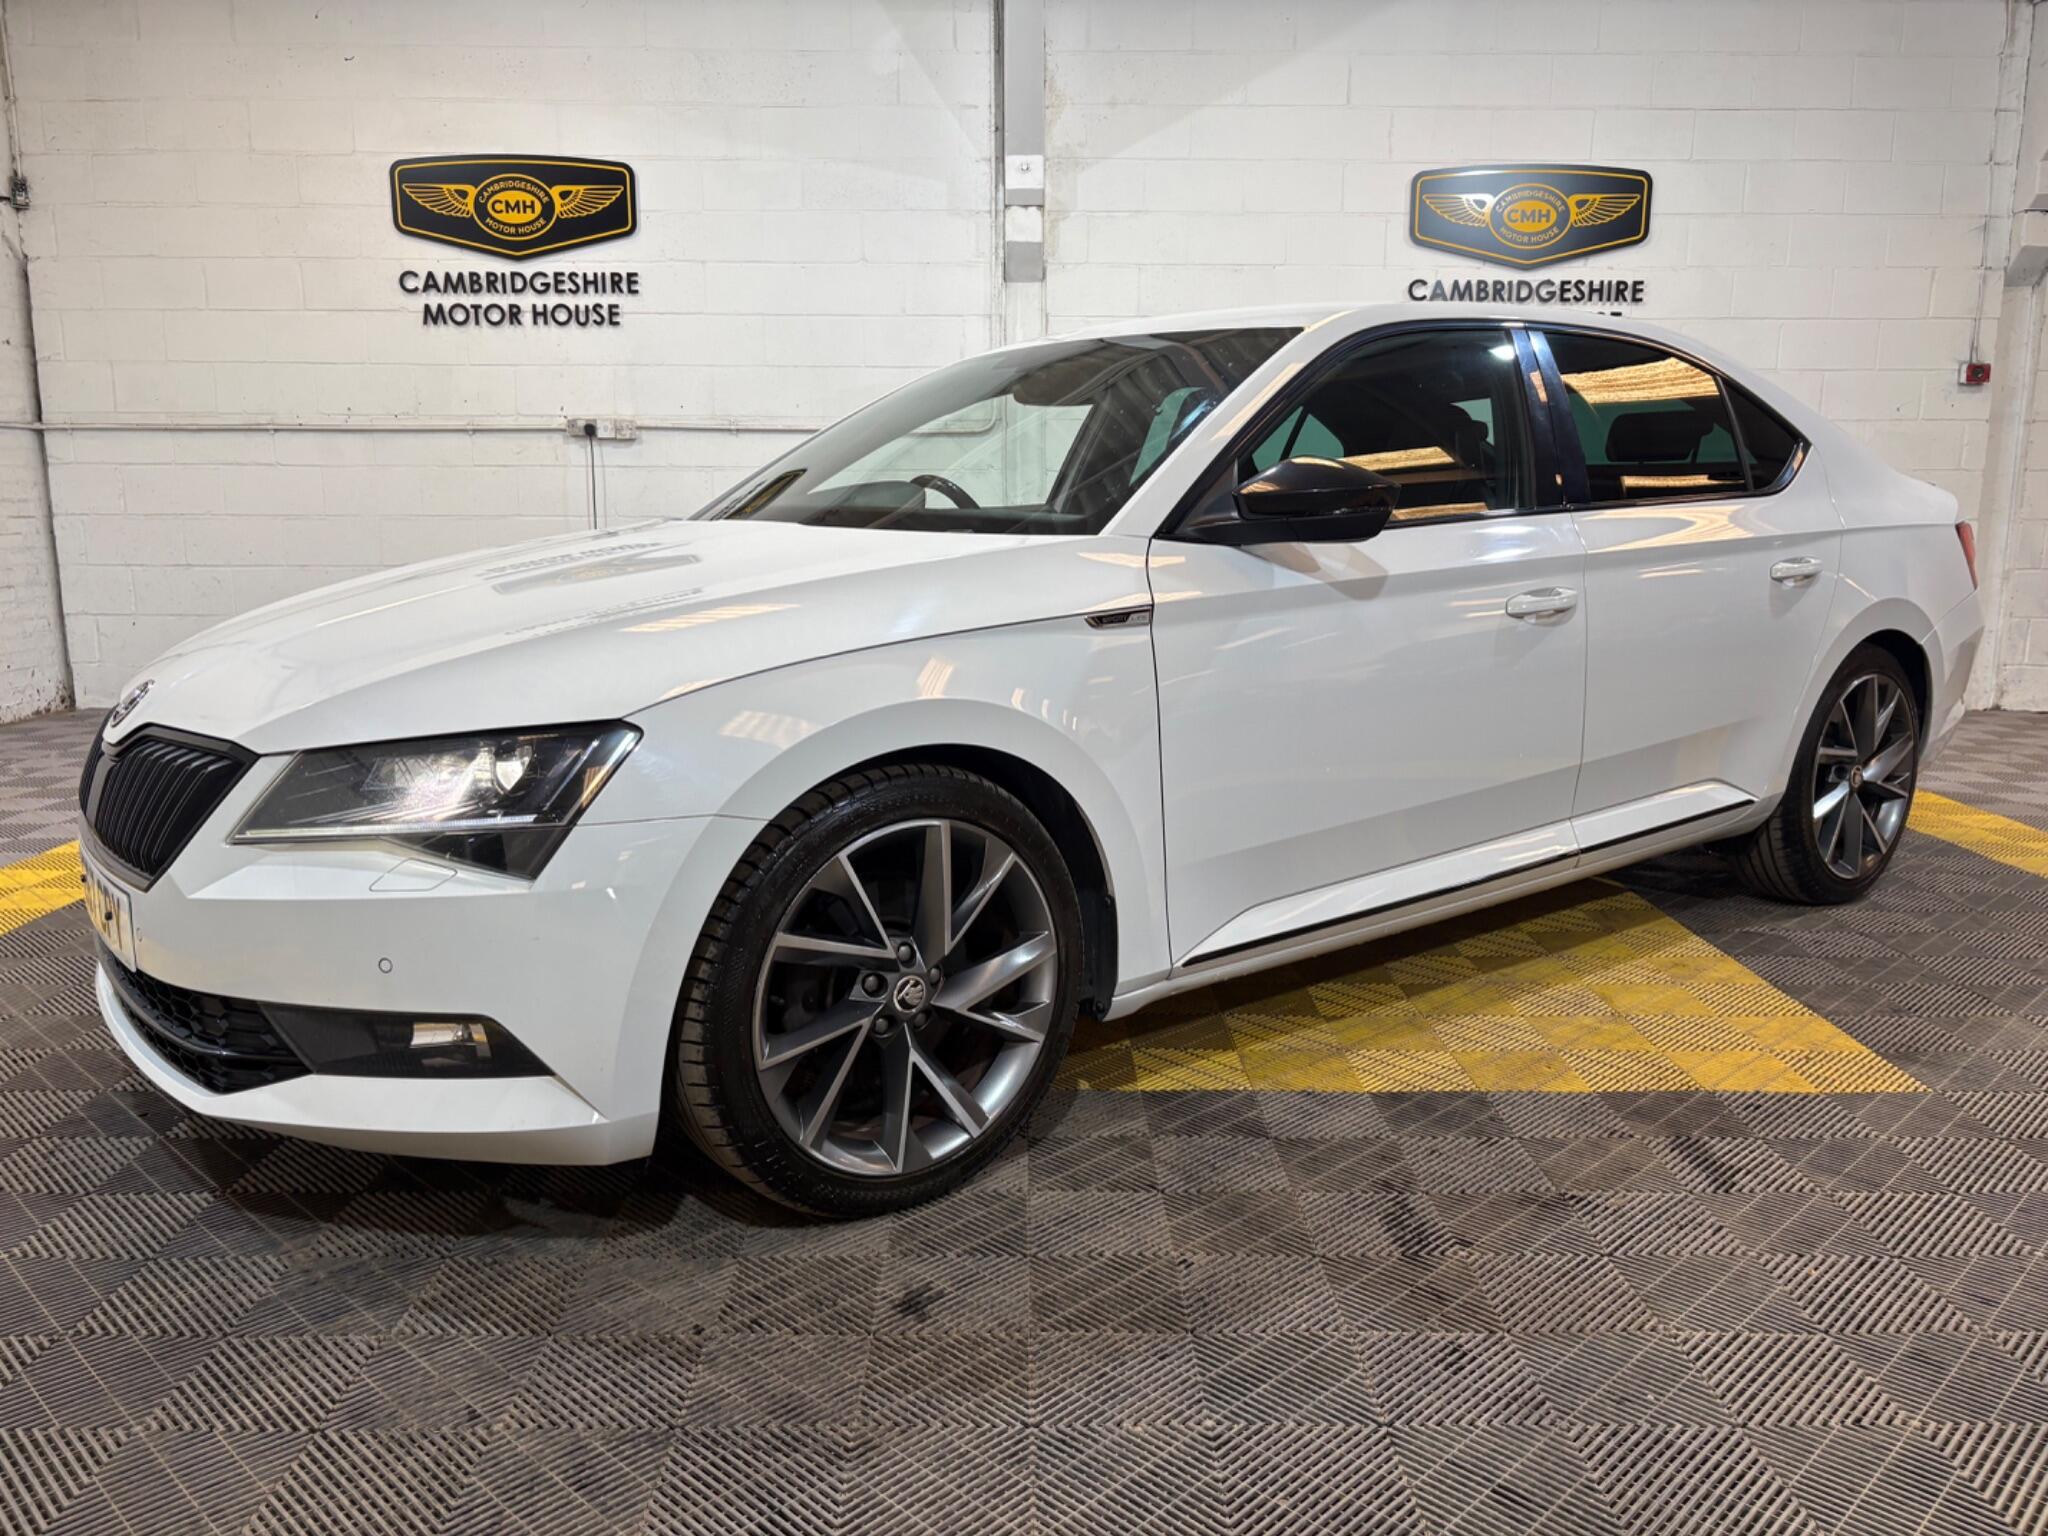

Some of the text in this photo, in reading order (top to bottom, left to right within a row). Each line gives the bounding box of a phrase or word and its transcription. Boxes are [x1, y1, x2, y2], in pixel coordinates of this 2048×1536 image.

[479, 181, 550, 203] CAMBRIDGESHIRE
[1496, 190, 1565, 212] CAMBRIDGESHIRE
[492, 200, 535, 214] CMH
[1507, 208, 1551, 223] CMH
[485, 217, 547, 234] MOTOR HOUSE
[1500, 226, 1559, 243] MOTOR HOUSE
[399, 271, 639, 294] CAMBRIDGESHIRE
[1408, 279, 1644, 303] CAMBRIDGESHIRE
[423, 303, 621, 326] MOTOR HOUSE
